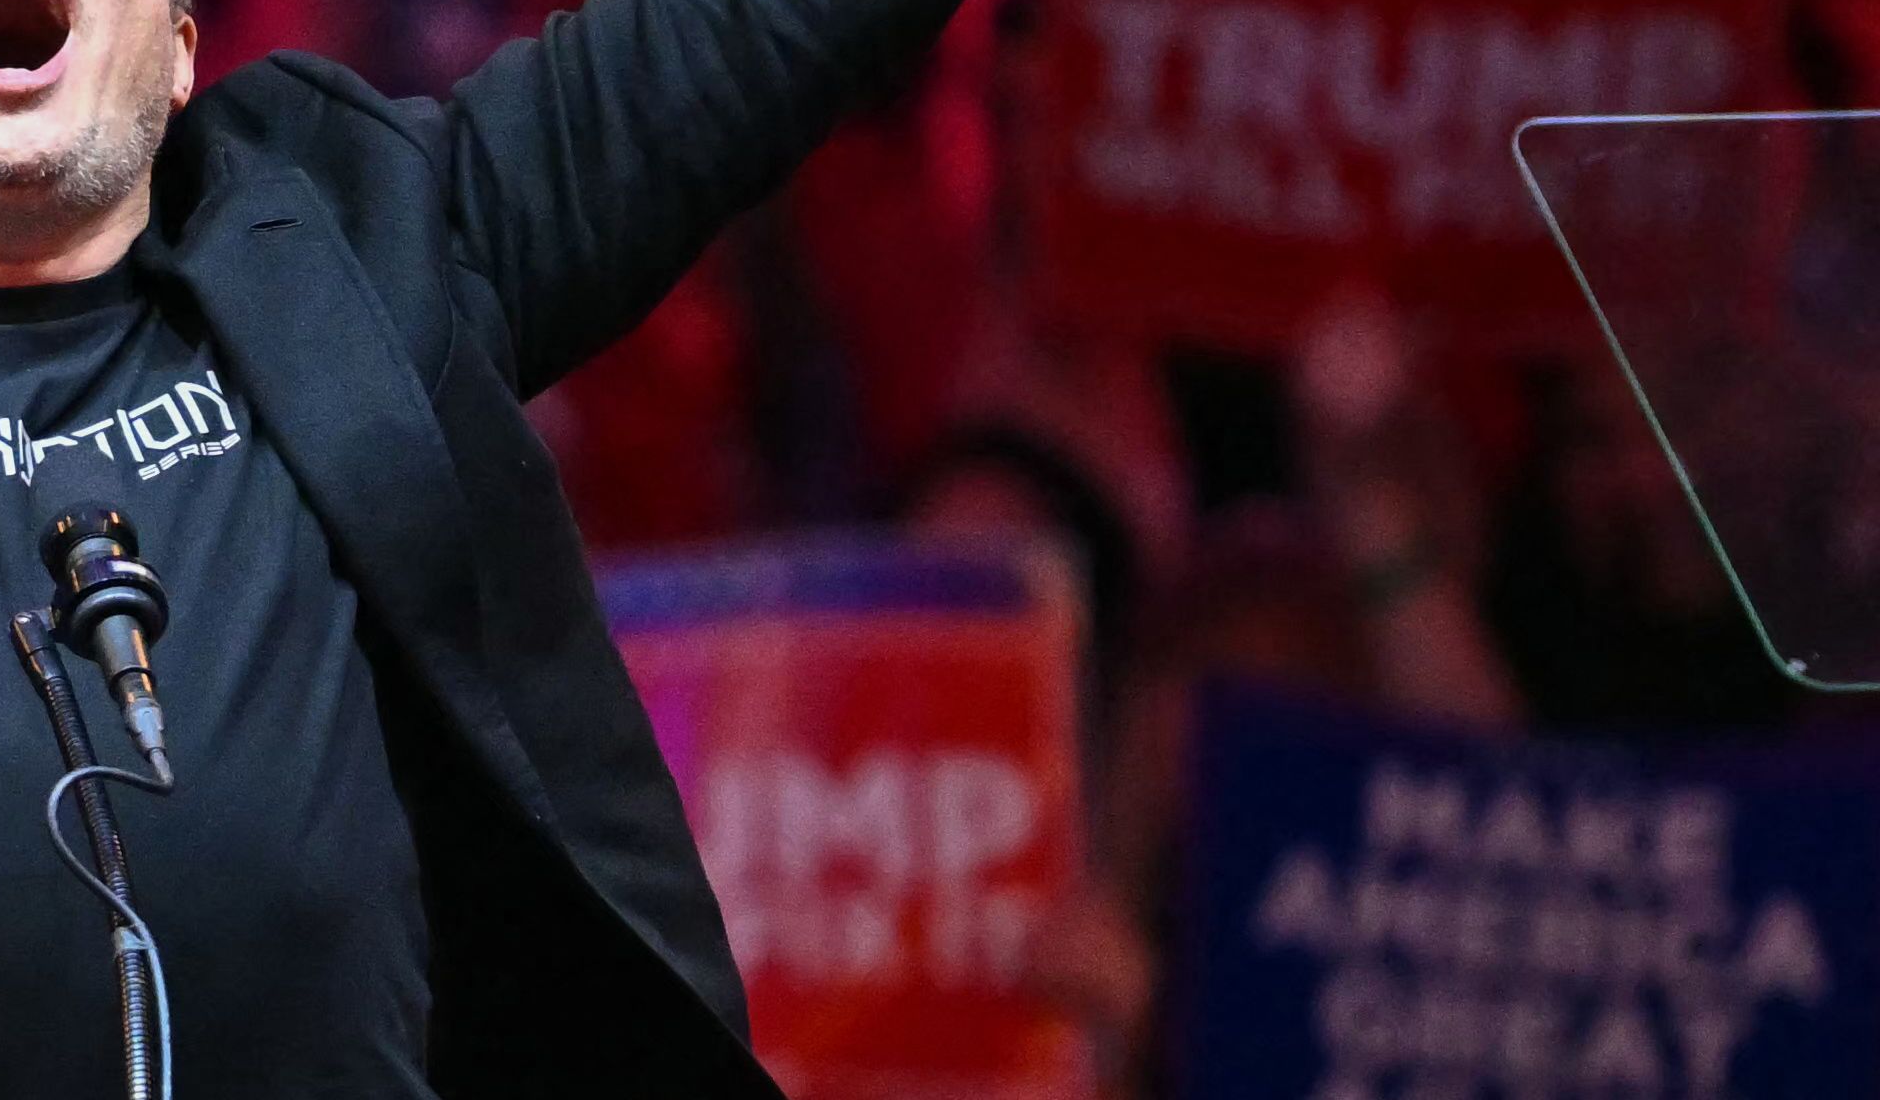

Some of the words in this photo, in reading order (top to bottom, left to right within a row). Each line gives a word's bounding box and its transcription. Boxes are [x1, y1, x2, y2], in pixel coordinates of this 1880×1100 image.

[138, 432, 241, 481] SERIES
[1360, 760, 1732, 878] MAKE
[1252, 846, 1832, 998] AMERICA
[1312, 958, 1770, 1090] GREAT
